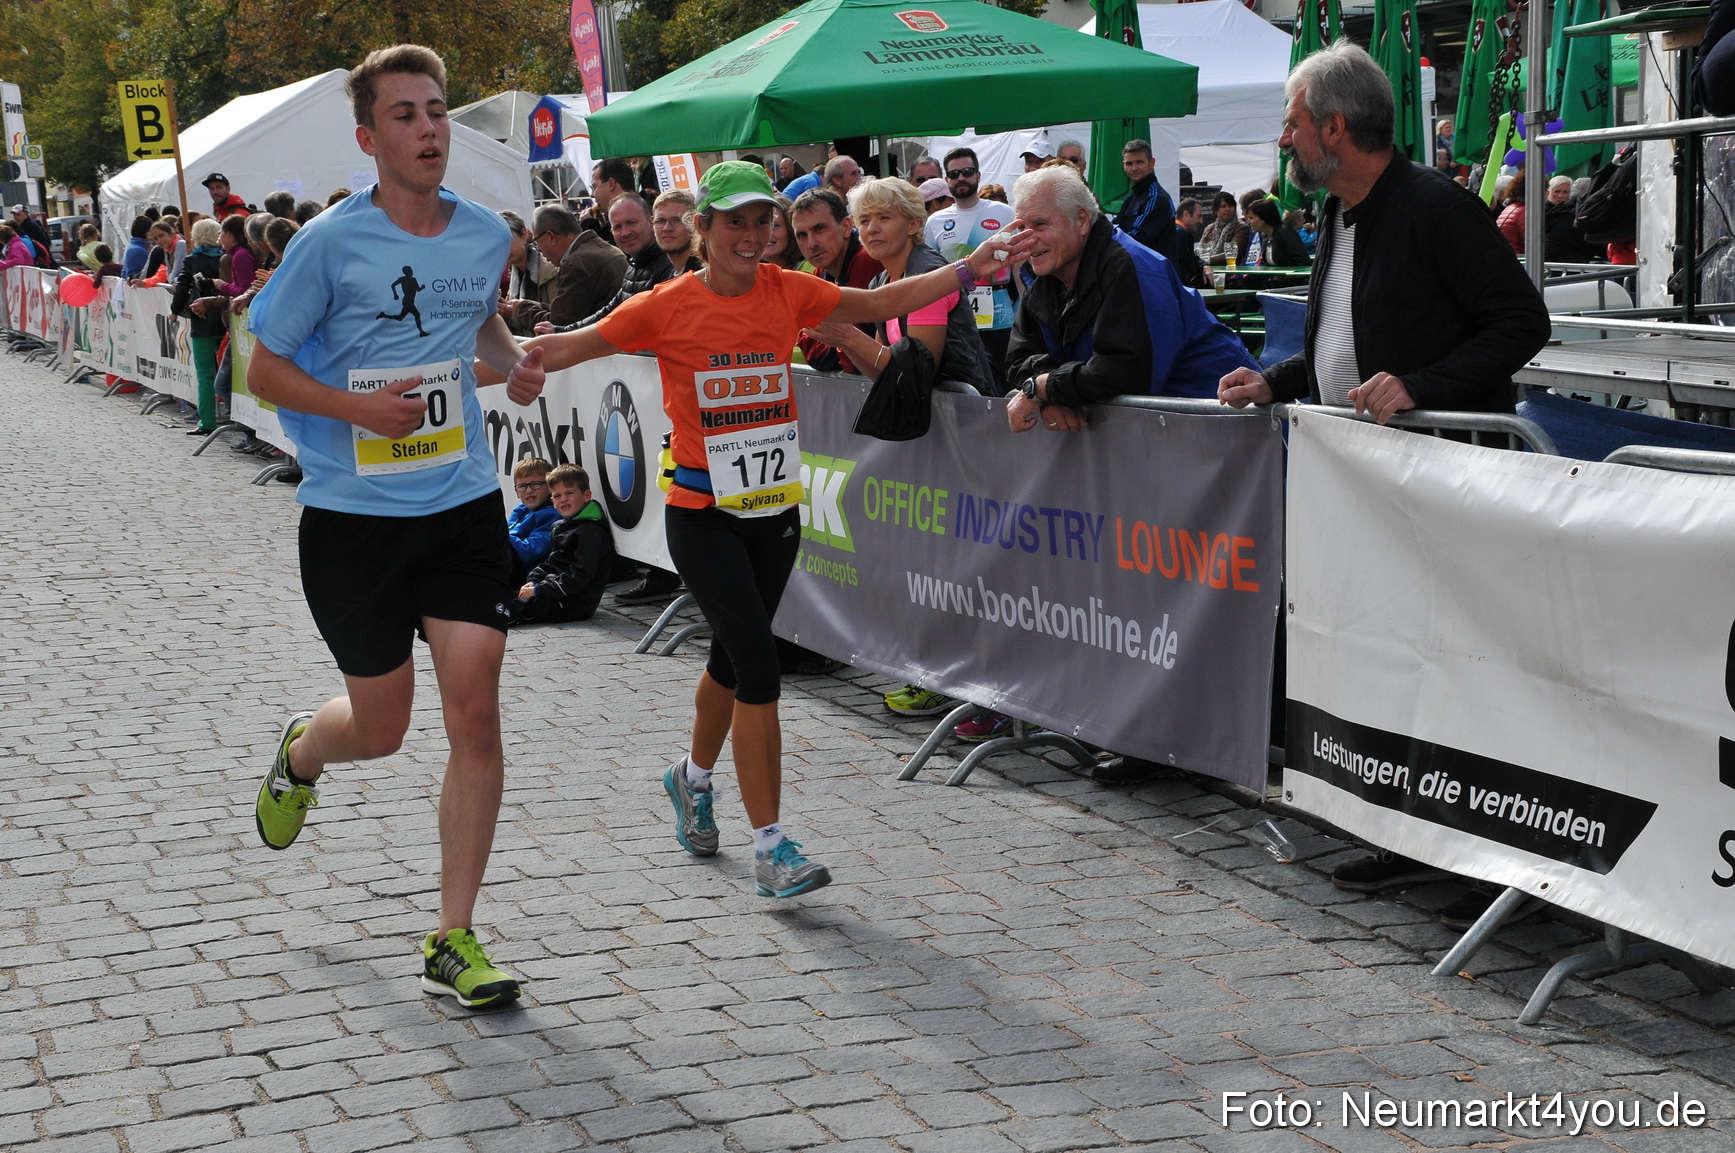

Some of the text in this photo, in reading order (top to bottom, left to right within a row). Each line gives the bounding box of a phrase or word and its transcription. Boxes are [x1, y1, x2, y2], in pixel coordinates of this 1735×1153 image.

[879, 33, 1004, 50] Neumarkter
[863, 42, 1044, 65] Lammsbräu
[911, 64, 942, 73] FEINE
[125, 83, 167, 99] Block
[135, 104, 165, 143] B
[533, 118, 554, 139] Hervis
[432, 277, 487, 293] GYM HIP
[441, 299, 483, 309] P-Seminar
[708, 351, 775, 368] 30 Jahre
[703, 373, 783, 400] OBI
[601, 384, 639, 435] BMW
[700, 401, 790, 429] Neumarkt
[391, 441, 438, 459] Stefan
[708, 433, 786, 455] PARTL Neumarkt
[731, 447, 787, 488] 172
[741, 492, 785, 510] Sylvana
[863, 476, 1260, 593] OFFICE INDUSTRY LOUNGE
[806, 553, 858, 588] concepts
[906, 570, 1178, 670] www.bockonline.de
[1313, 731, 1606, 848] Leistungen, die verbinden
